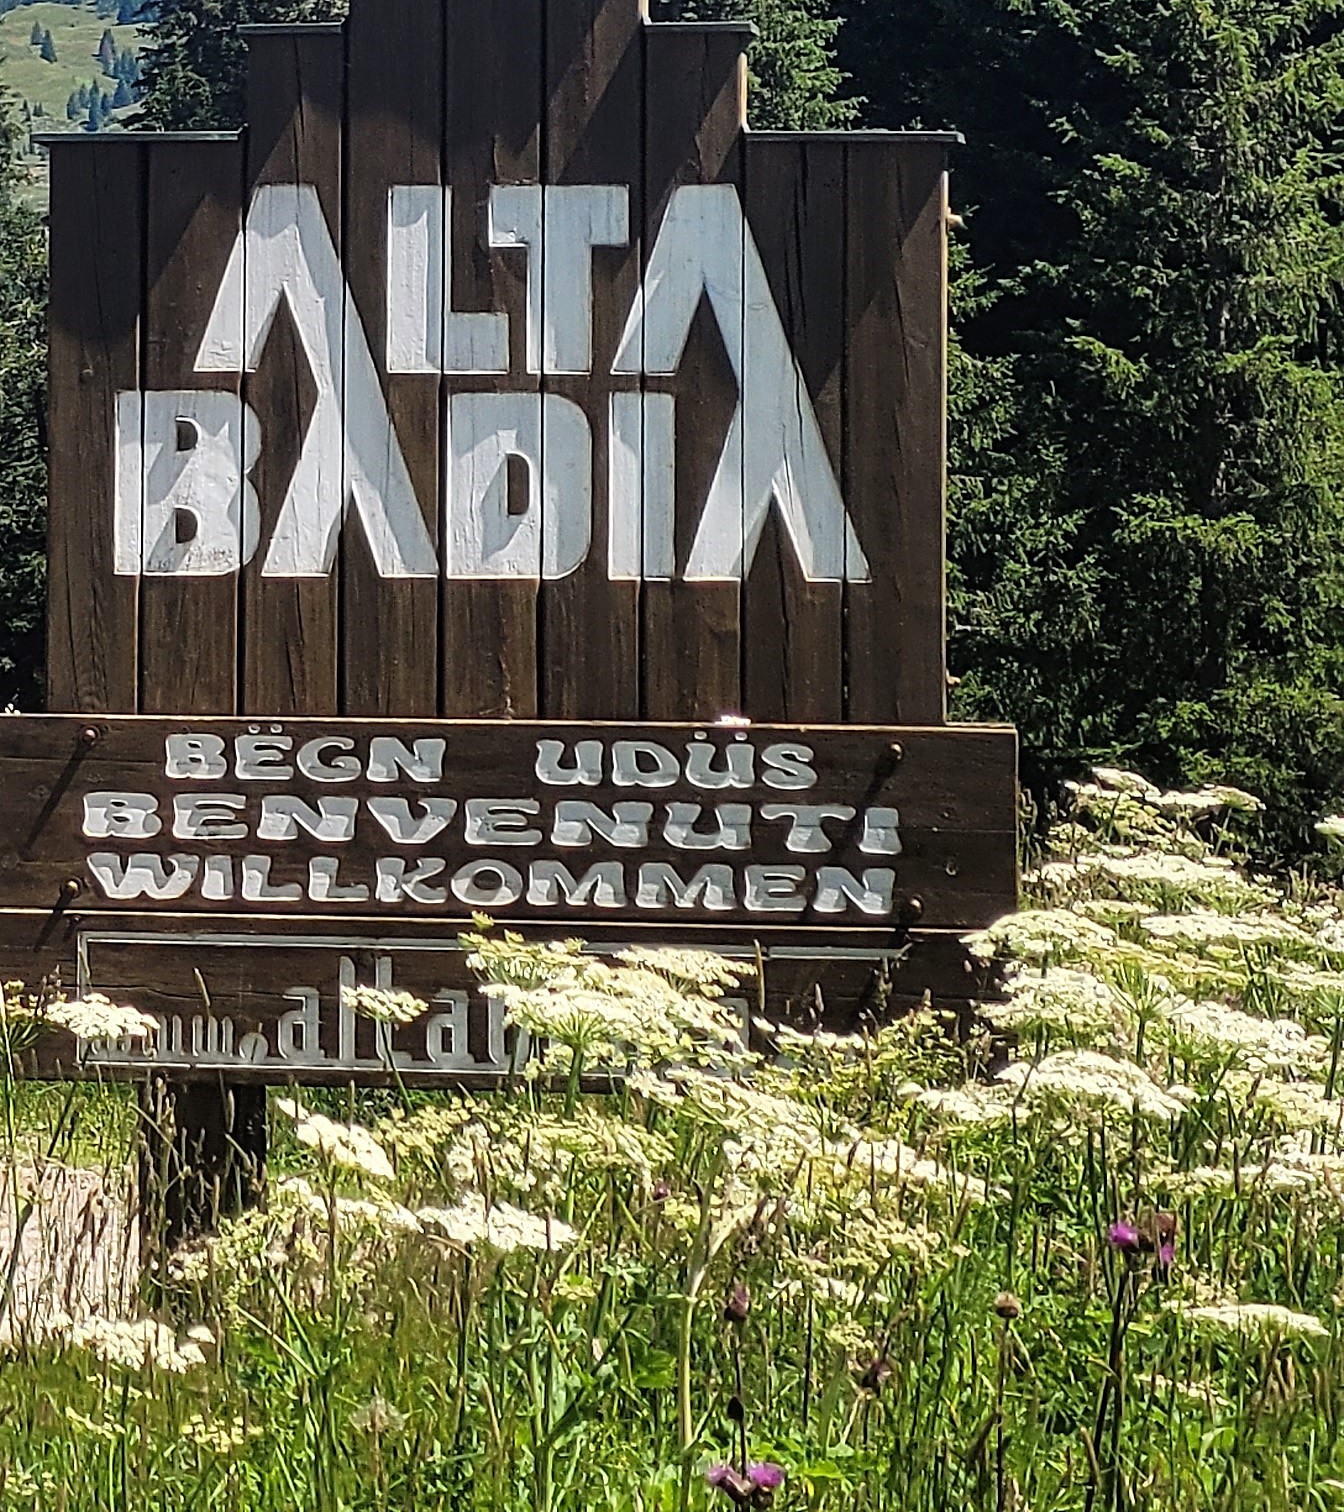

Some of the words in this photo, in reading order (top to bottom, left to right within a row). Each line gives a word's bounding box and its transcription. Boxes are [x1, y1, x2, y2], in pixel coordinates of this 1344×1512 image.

[192, 183, 801, 377] ALTA
[113, 389, 871, 583] BADIA
[163, 721, 448, 783] BËGN
[535, 730, 818, 790] UDÜS
[80, 790, 901, 855] BENVENUTI
[87, 852, 897, 915] WILLKOMMEN
